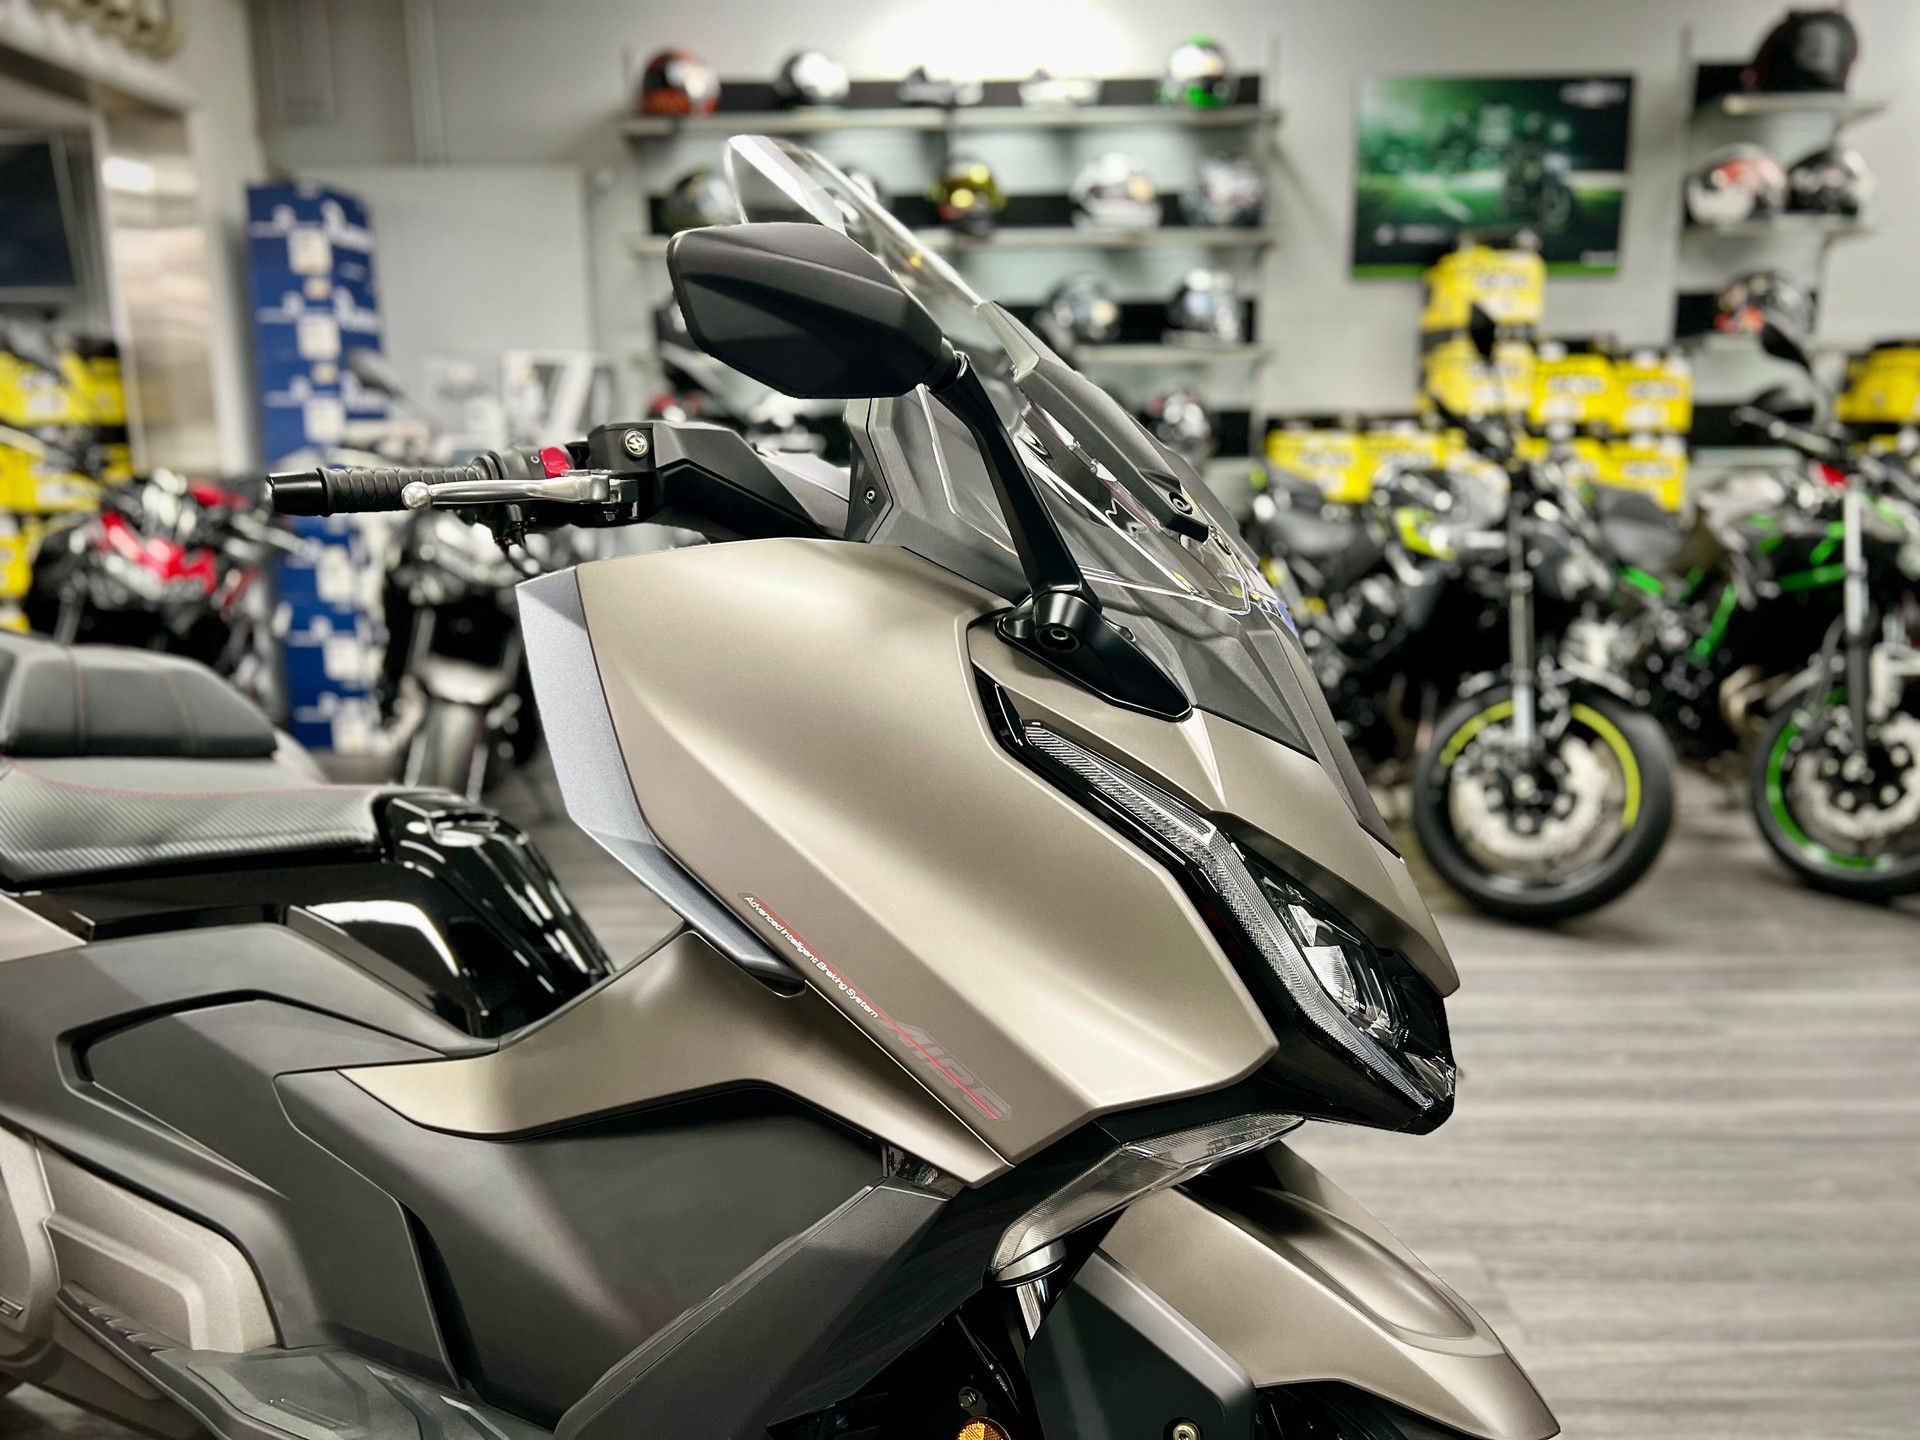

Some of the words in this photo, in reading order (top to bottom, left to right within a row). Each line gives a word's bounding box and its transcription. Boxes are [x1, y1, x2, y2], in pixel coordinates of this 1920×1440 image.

[744, 896, 785, 932] Advanced
[781, 927, 819, 963] Intelligent
[815, 962, 848, 990] Braking
[845, 988, 879, 1018] System
